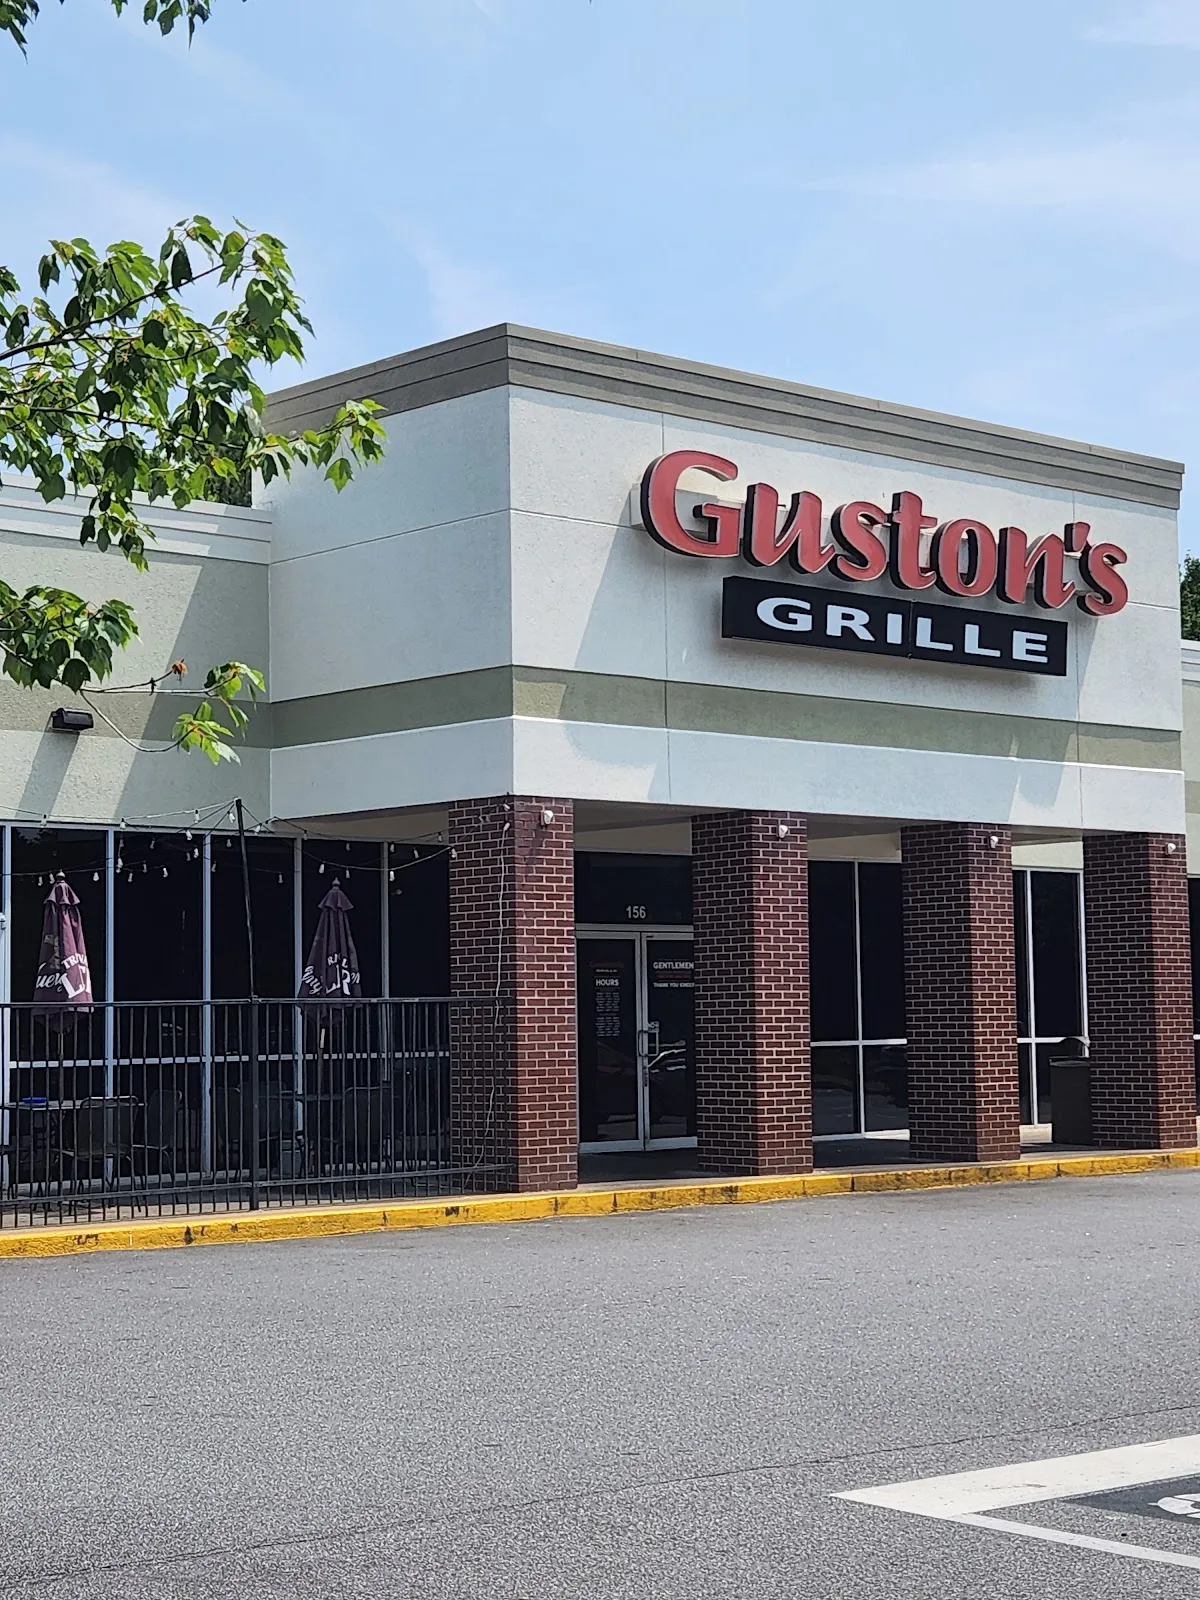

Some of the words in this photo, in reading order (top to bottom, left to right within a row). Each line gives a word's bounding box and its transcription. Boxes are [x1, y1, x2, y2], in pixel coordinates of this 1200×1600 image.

[641, 450, 1128, 616] Guston's
[756, 597, 1049, 663] GRILLE
[626, 905, 646, 918] 156
